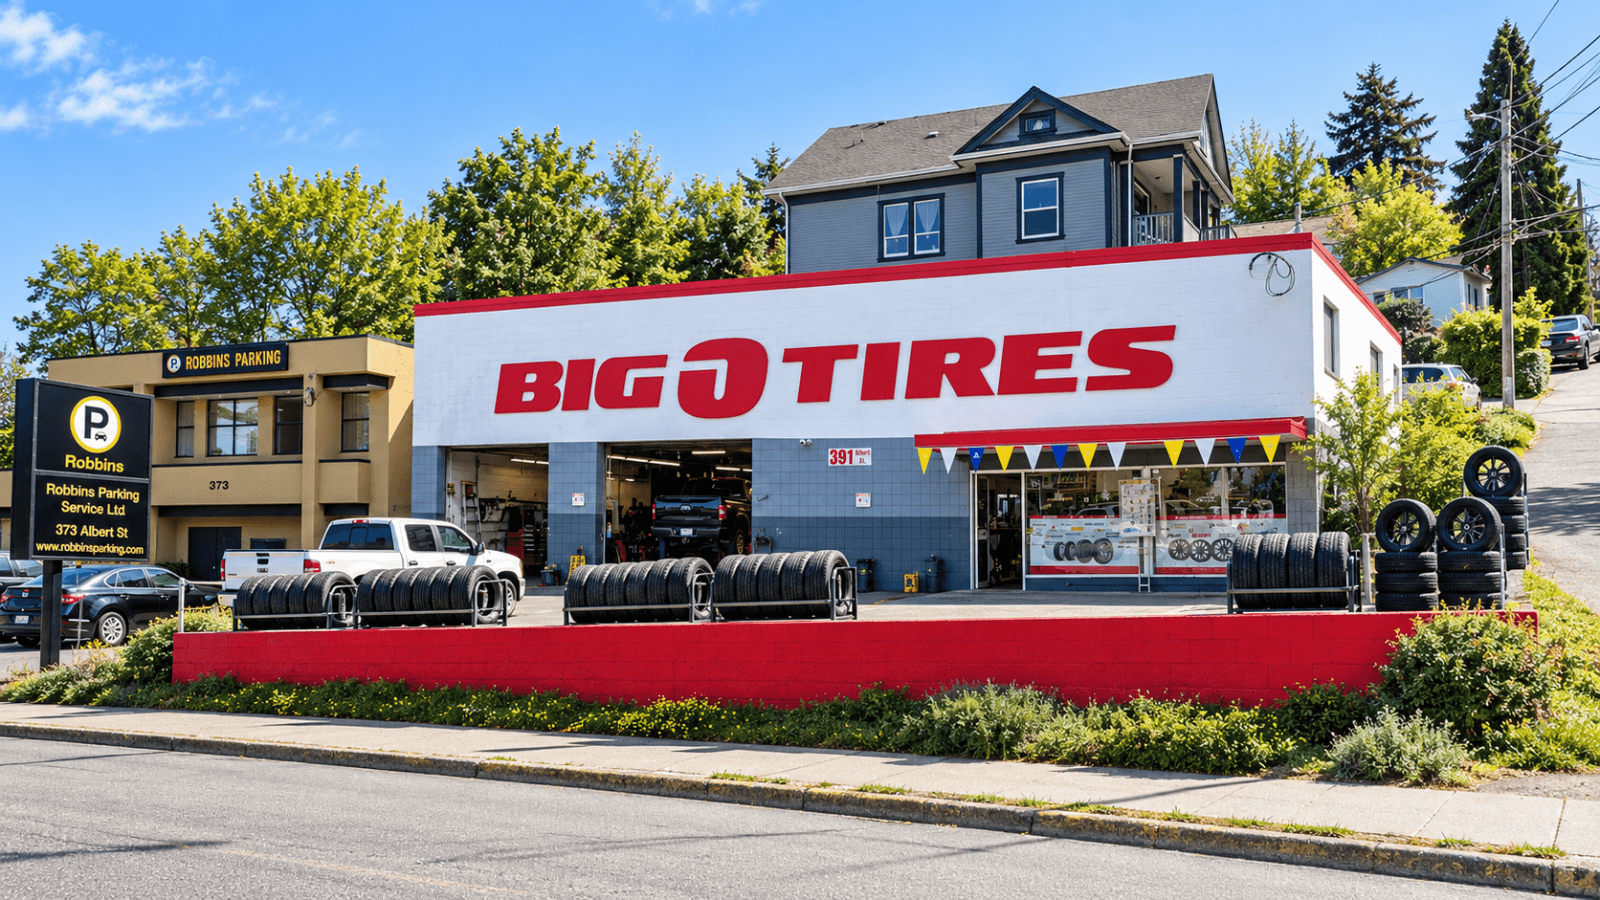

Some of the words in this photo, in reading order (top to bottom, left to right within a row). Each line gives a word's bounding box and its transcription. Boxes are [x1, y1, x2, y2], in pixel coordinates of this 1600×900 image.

[185, 353, 231, 370] ROBBINS
[235, 349, 281, 367] PARKING
[494, 354, 668, 414] BIG
[677, 338, 768, 418] O
[782, 325, 1176, 403] TIRES
[84, 405, 109, 439] P
[65, 454, 124, 473] Robbins
[830, 449, 853, 465] 391
[46, 482, 95, 498] Robbins
[98, 487, 140, 503] Parking
[209, 480, 229, 490] 373
[61, 501, 104, 515] Service
[107, 504, 126, 516] Ltd
[55, 524, 77, 536] 373
[80, 525, 114, 538] Albert
[117, 527, 129, 538] St
[36, 542, 144, 556] www.robbinsparking.com
